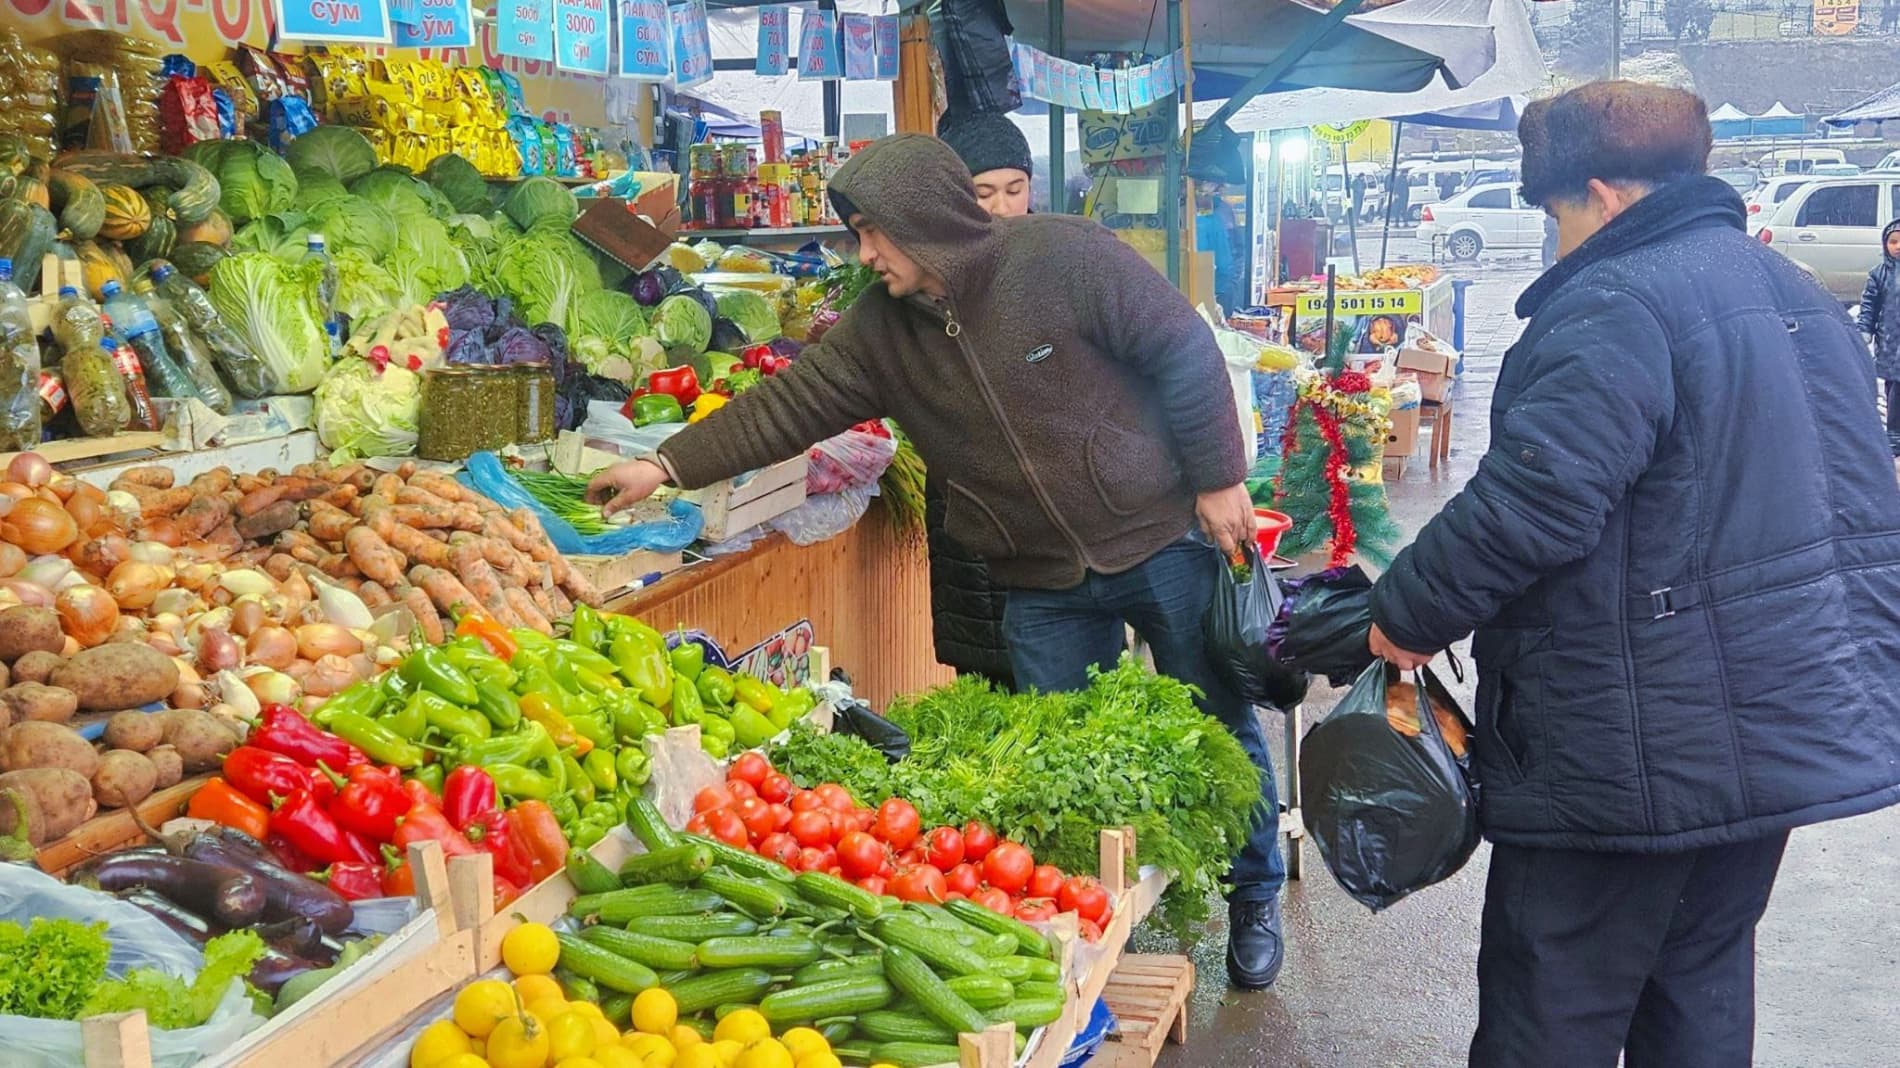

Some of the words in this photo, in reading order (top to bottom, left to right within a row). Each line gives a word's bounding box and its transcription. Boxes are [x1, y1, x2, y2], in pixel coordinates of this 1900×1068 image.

[515, 6, 539, 21] 5000
[566, 13, 595, 34] 3000
[1341, 298, 1365, 309] 501
[1370, 298, 1385, 309] 15
[1391, 297, 1405, 308] 14
